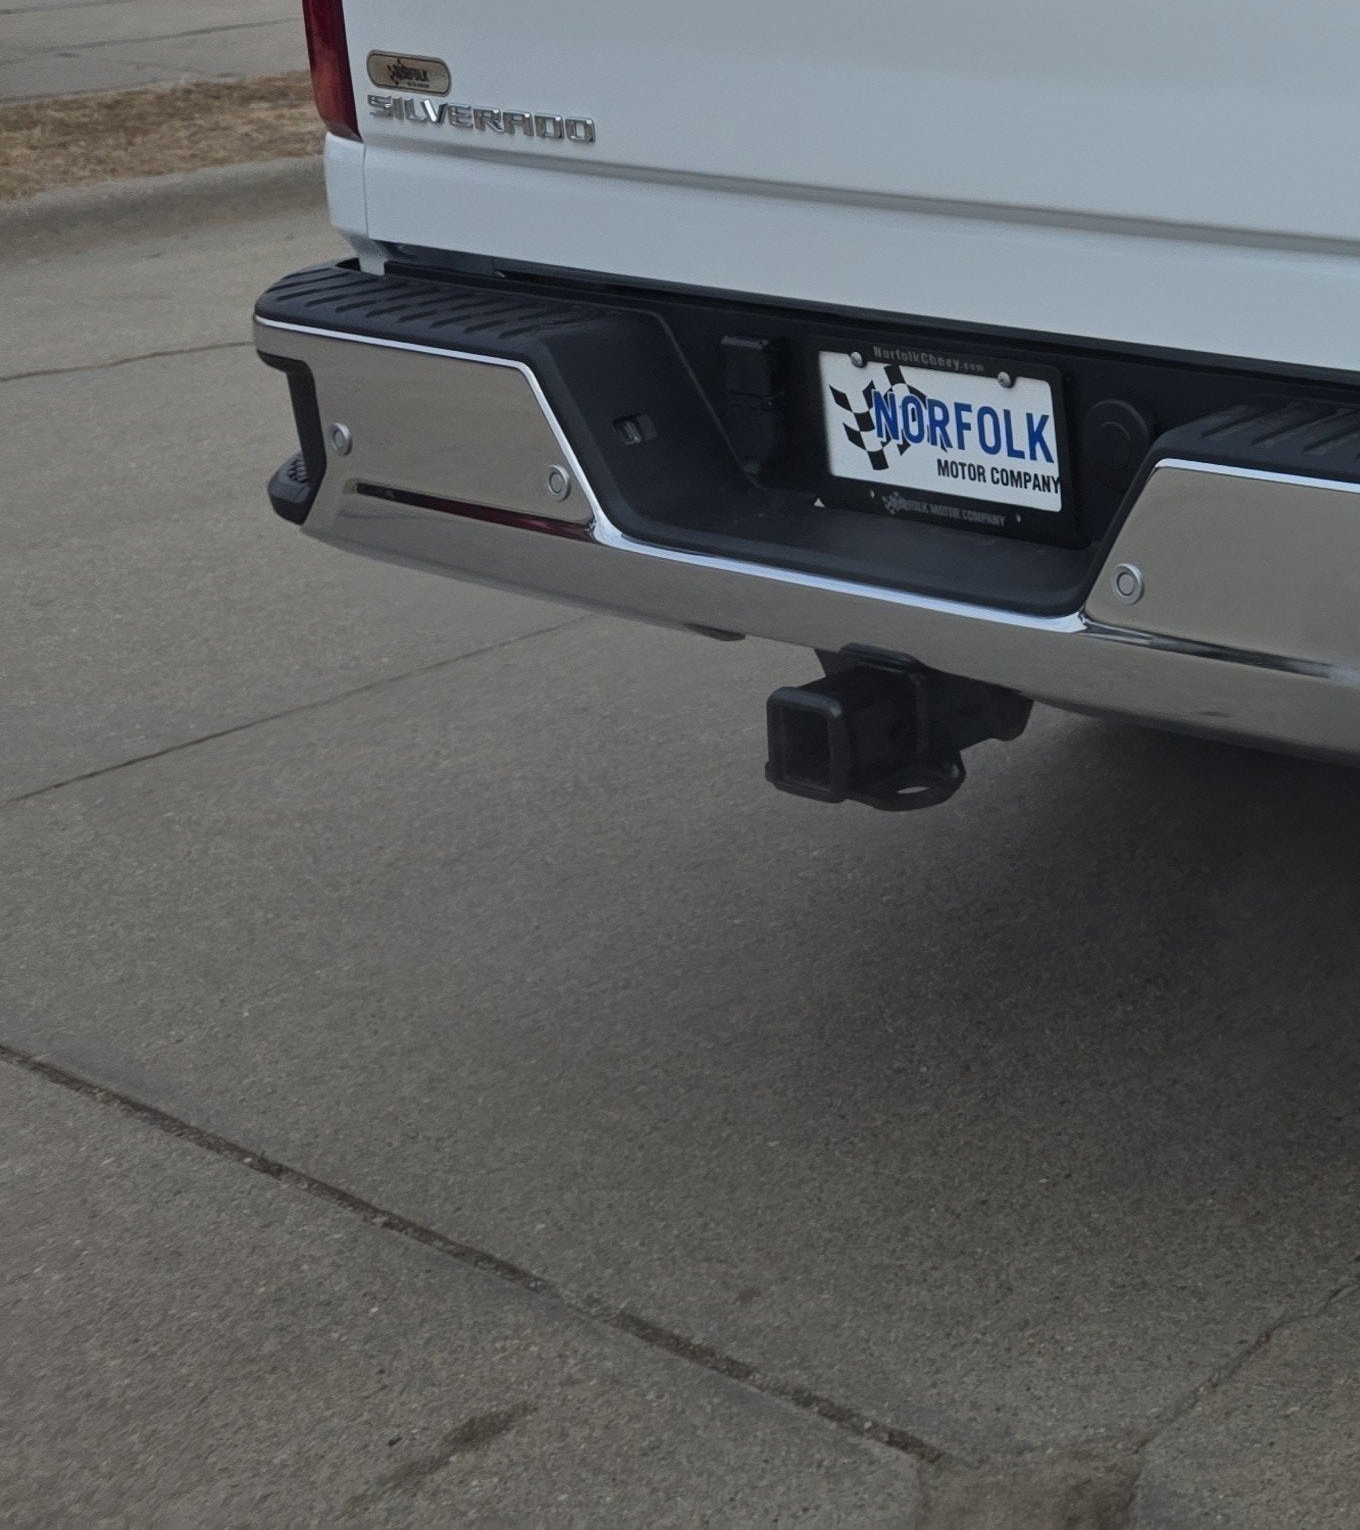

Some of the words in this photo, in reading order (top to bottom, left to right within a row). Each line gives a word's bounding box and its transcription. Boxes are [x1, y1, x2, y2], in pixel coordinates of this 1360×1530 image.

[366, 94, 597, 145] SILVERADO
[872, 389, 1055, 465] NORFOLK
[936, 458, 987, 484] MOTOR
[990, 465, 1061, 494] COMPANY
